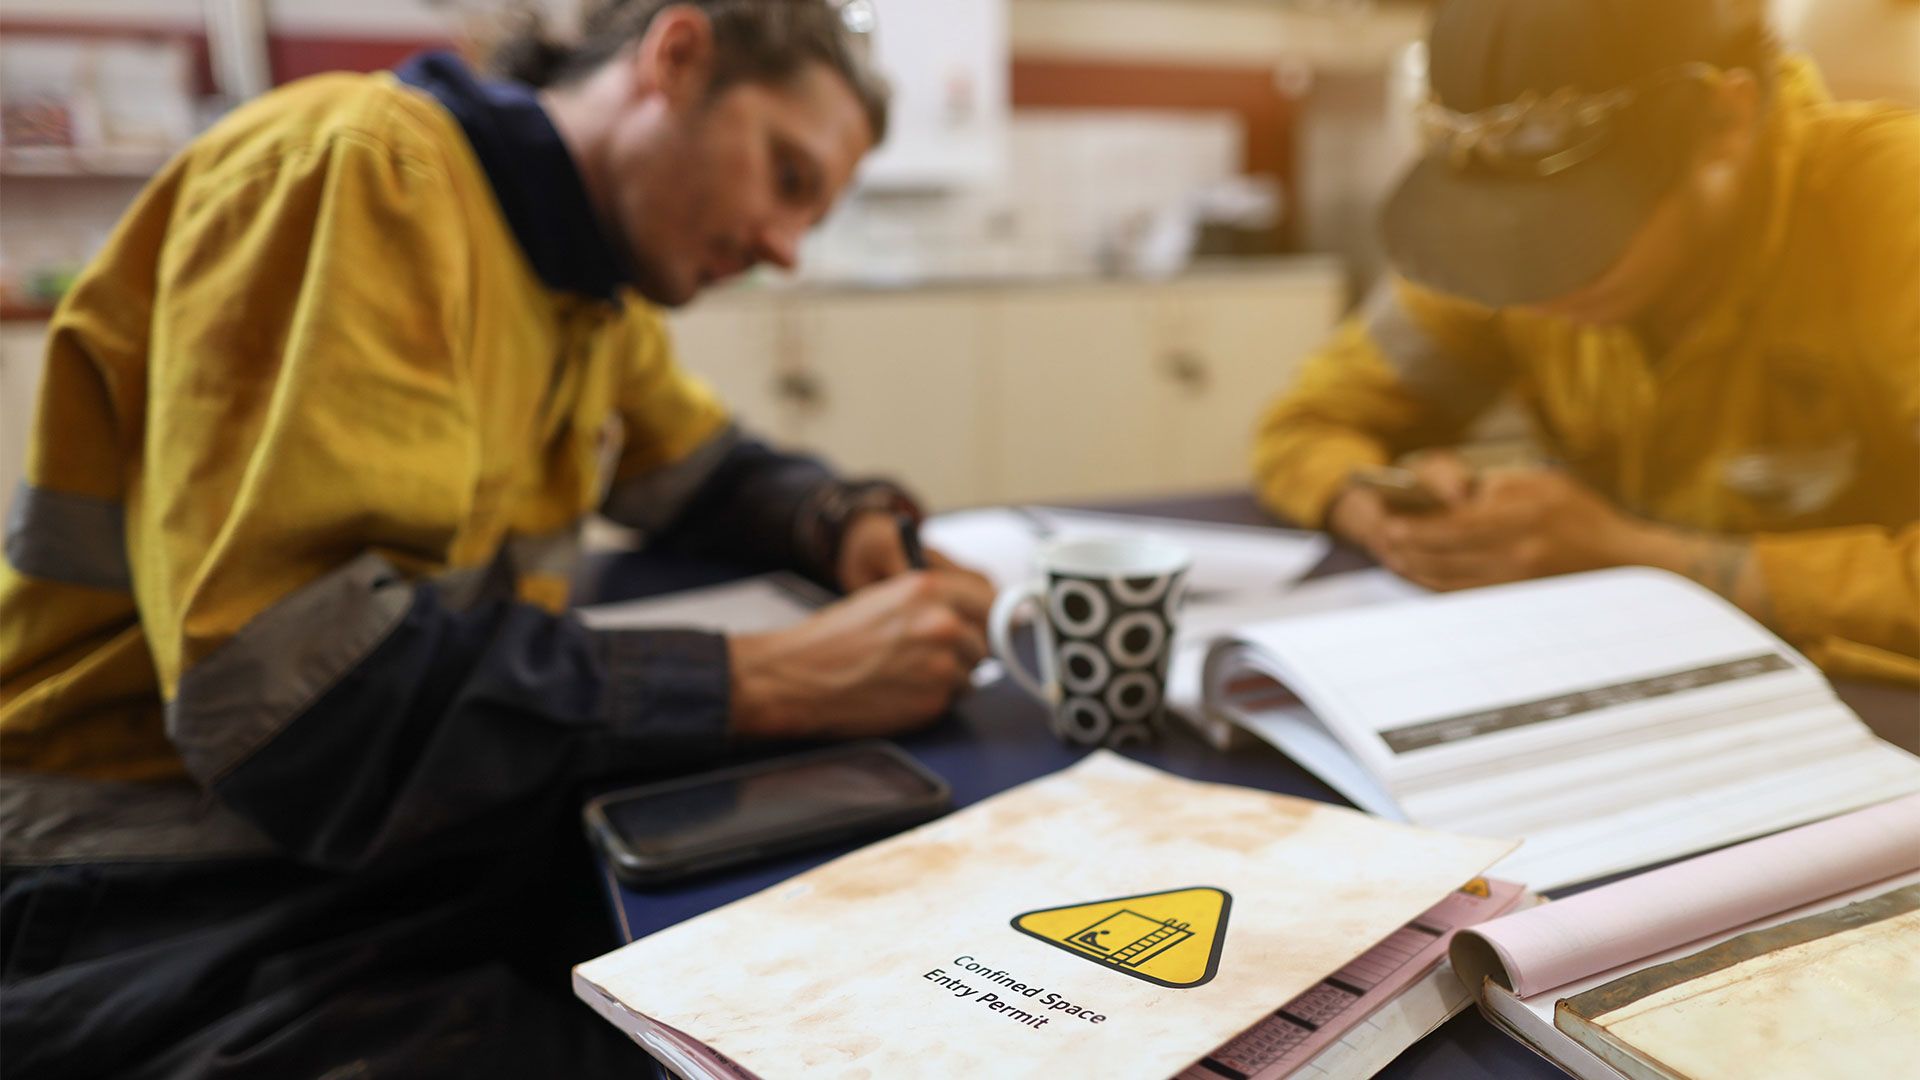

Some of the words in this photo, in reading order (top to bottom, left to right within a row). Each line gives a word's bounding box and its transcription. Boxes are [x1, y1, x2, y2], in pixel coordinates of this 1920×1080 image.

[923, 968, 979, 998] Entry
[975, 992, 1050, 1029] Permit
[953, 955, 1044, 998] Confined
[1039, 993, 1107, 1025] Space
